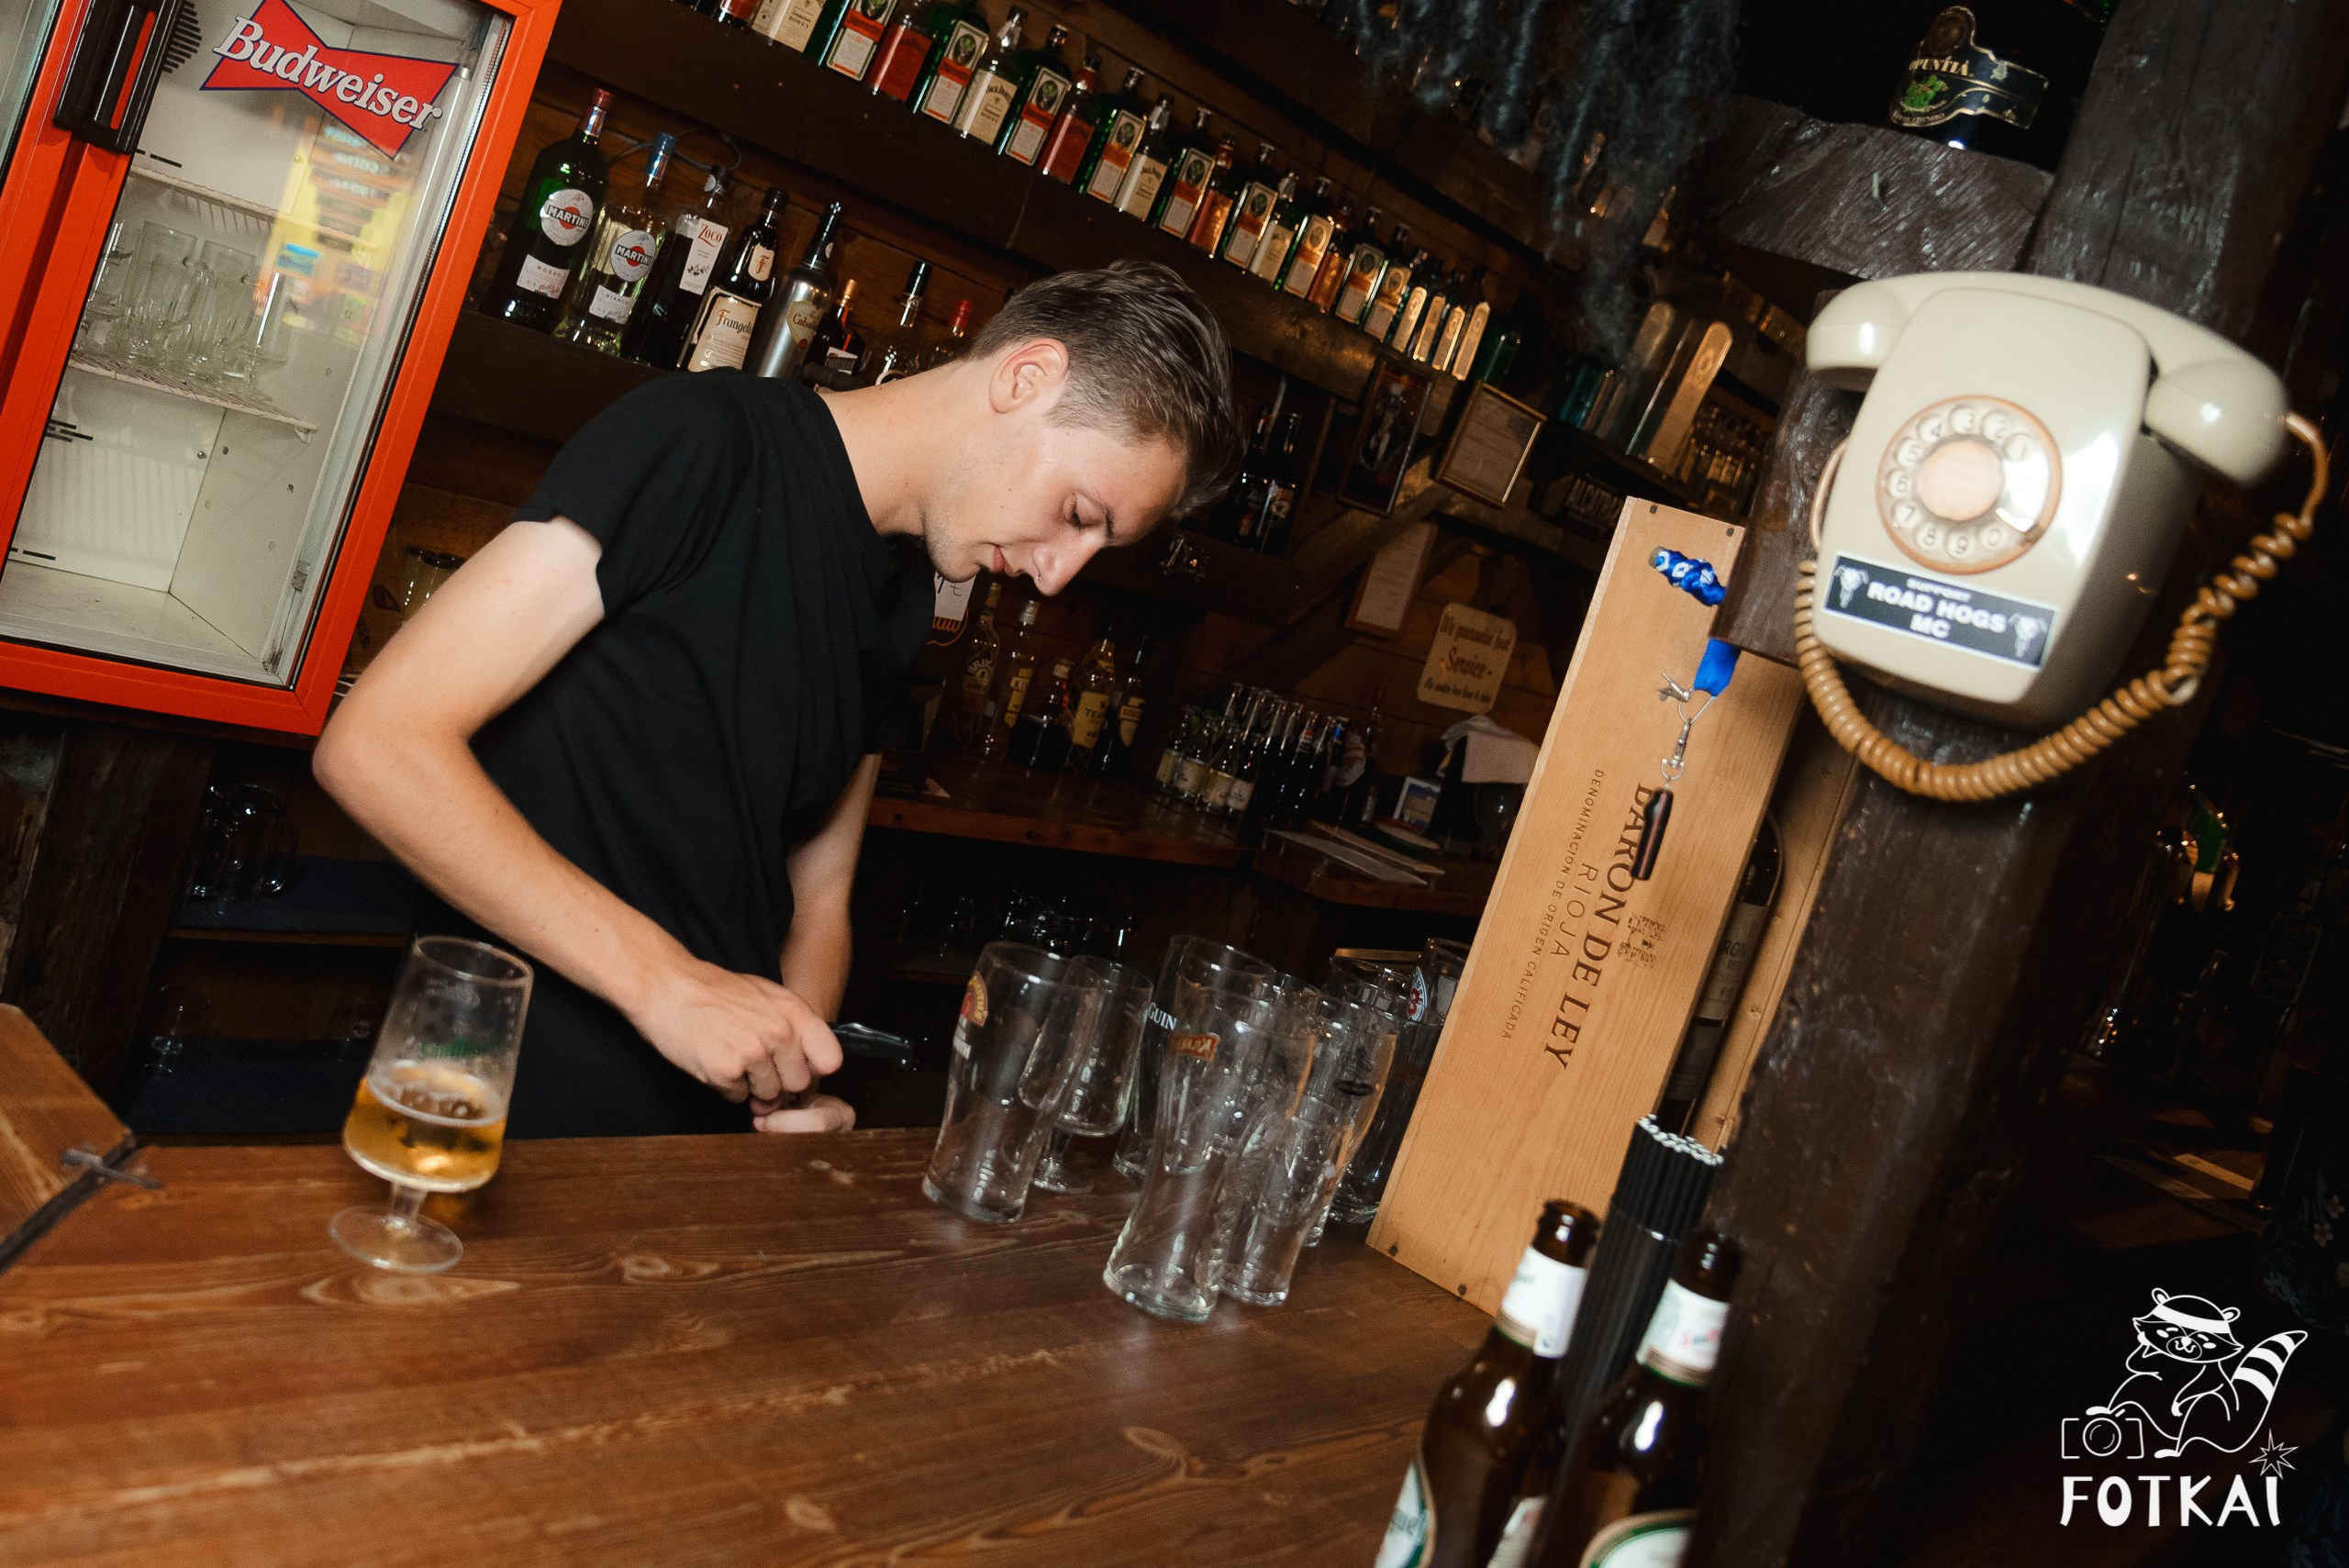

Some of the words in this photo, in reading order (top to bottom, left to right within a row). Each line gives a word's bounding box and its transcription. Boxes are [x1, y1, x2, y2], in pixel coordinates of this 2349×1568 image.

[212, 15, 444, 130] Budweiser
[548, 204, 590, 229] MARTINI
[615, 244, 653, 266] MARTINI
[1866, 581, 1934, 613] ROAD
[1935, 598, 2008, 634] HOGS
[1906, 577, 1972, 603] SUPPORT
[1909, 613, 1952, 639] MC
[1550, 862, 1599, 958] RIOJA
[1553, 880, 1565, 899] DE
[1531, 903, 1556, 956] ORIGEN
[1571, 930, 1613, 987] DE
[1148, 1001, 1177, 1031] GUIN
[1501, 961, 1536, 1040] CALIFICADA
[1543, 991, 1591, 1070] LEY
